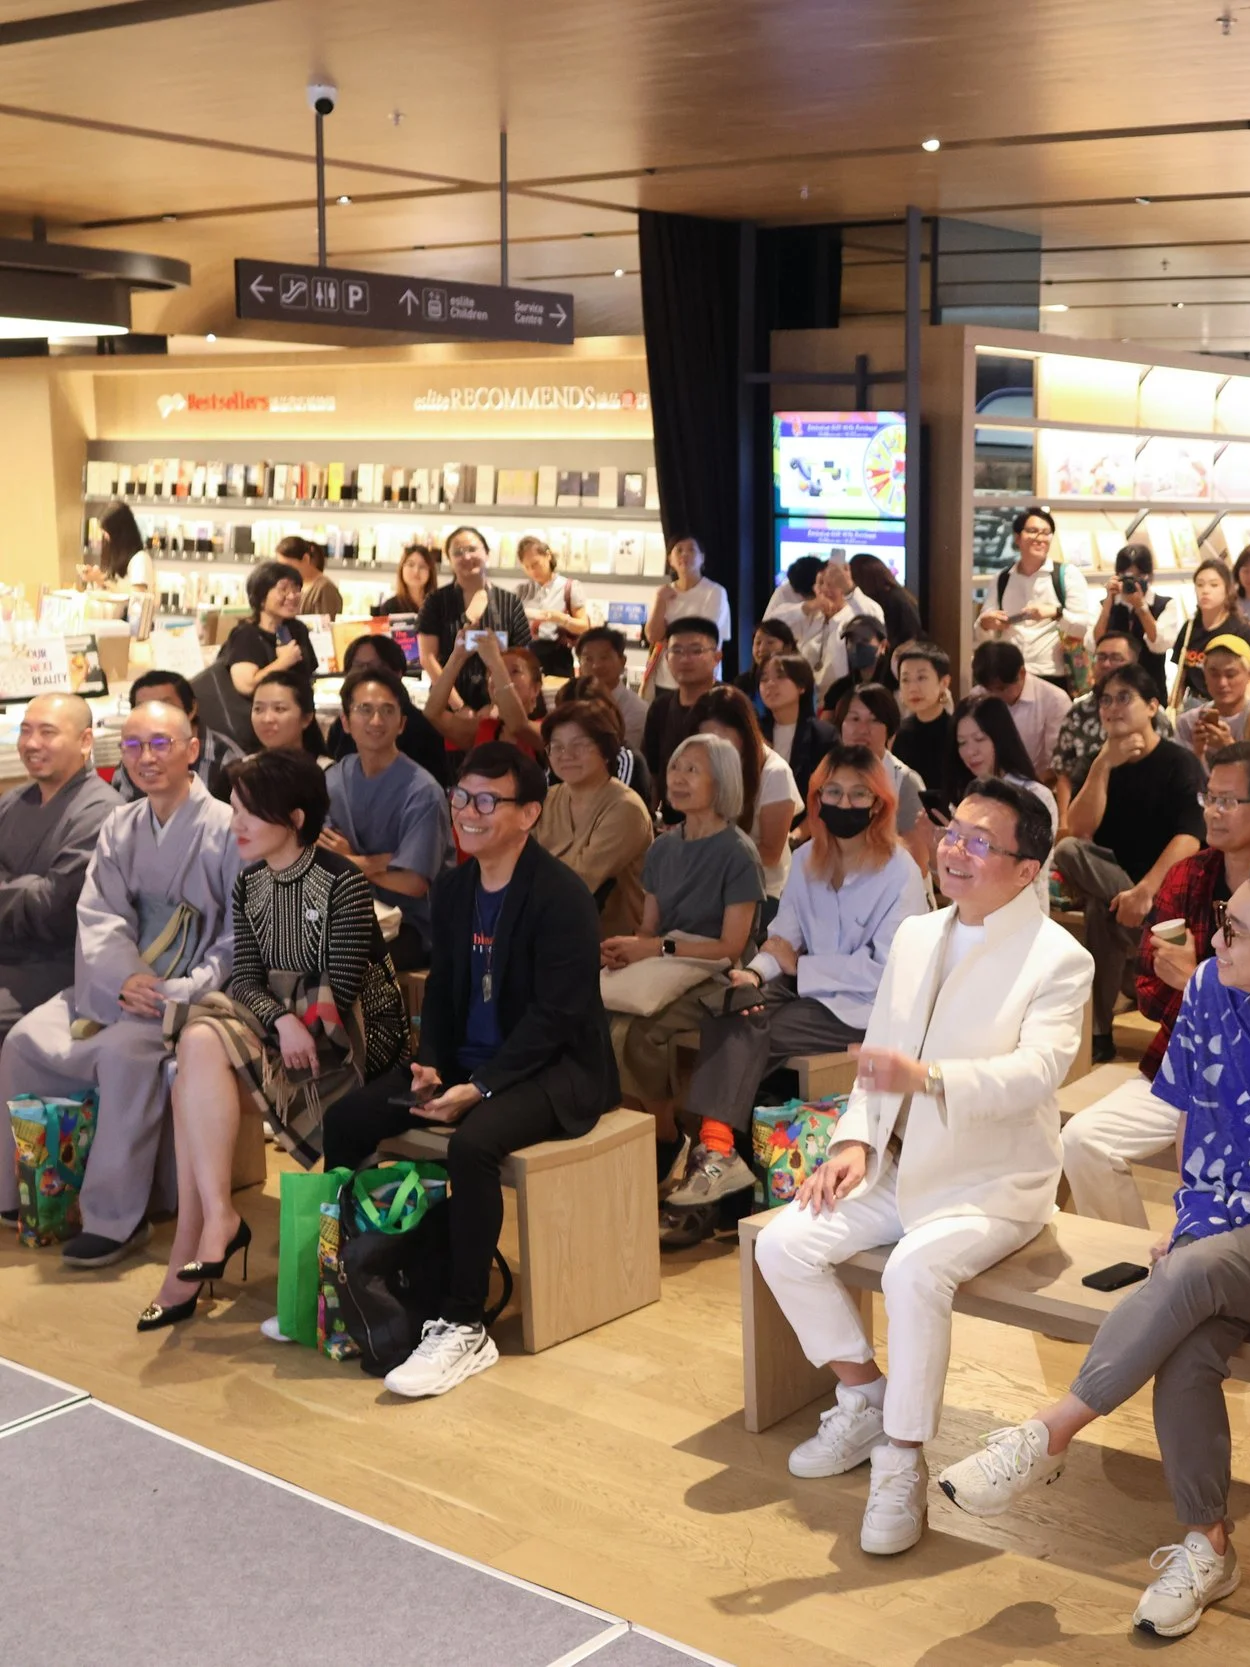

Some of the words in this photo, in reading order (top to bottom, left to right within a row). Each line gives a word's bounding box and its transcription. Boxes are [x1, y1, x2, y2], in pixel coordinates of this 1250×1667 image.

[349, 285, 363, 309] P
[450, 296, 475, 308] eslite
[514, 300, 544, 314] Service
[450, 308, 488, 321] Children
[514, 313, 543, 326] Centre
[187, 391, 269, 411] Bestsellers
[450, 386, 594, 410] RECOMMENDS
[32, 674, 67, 686] REALITY
